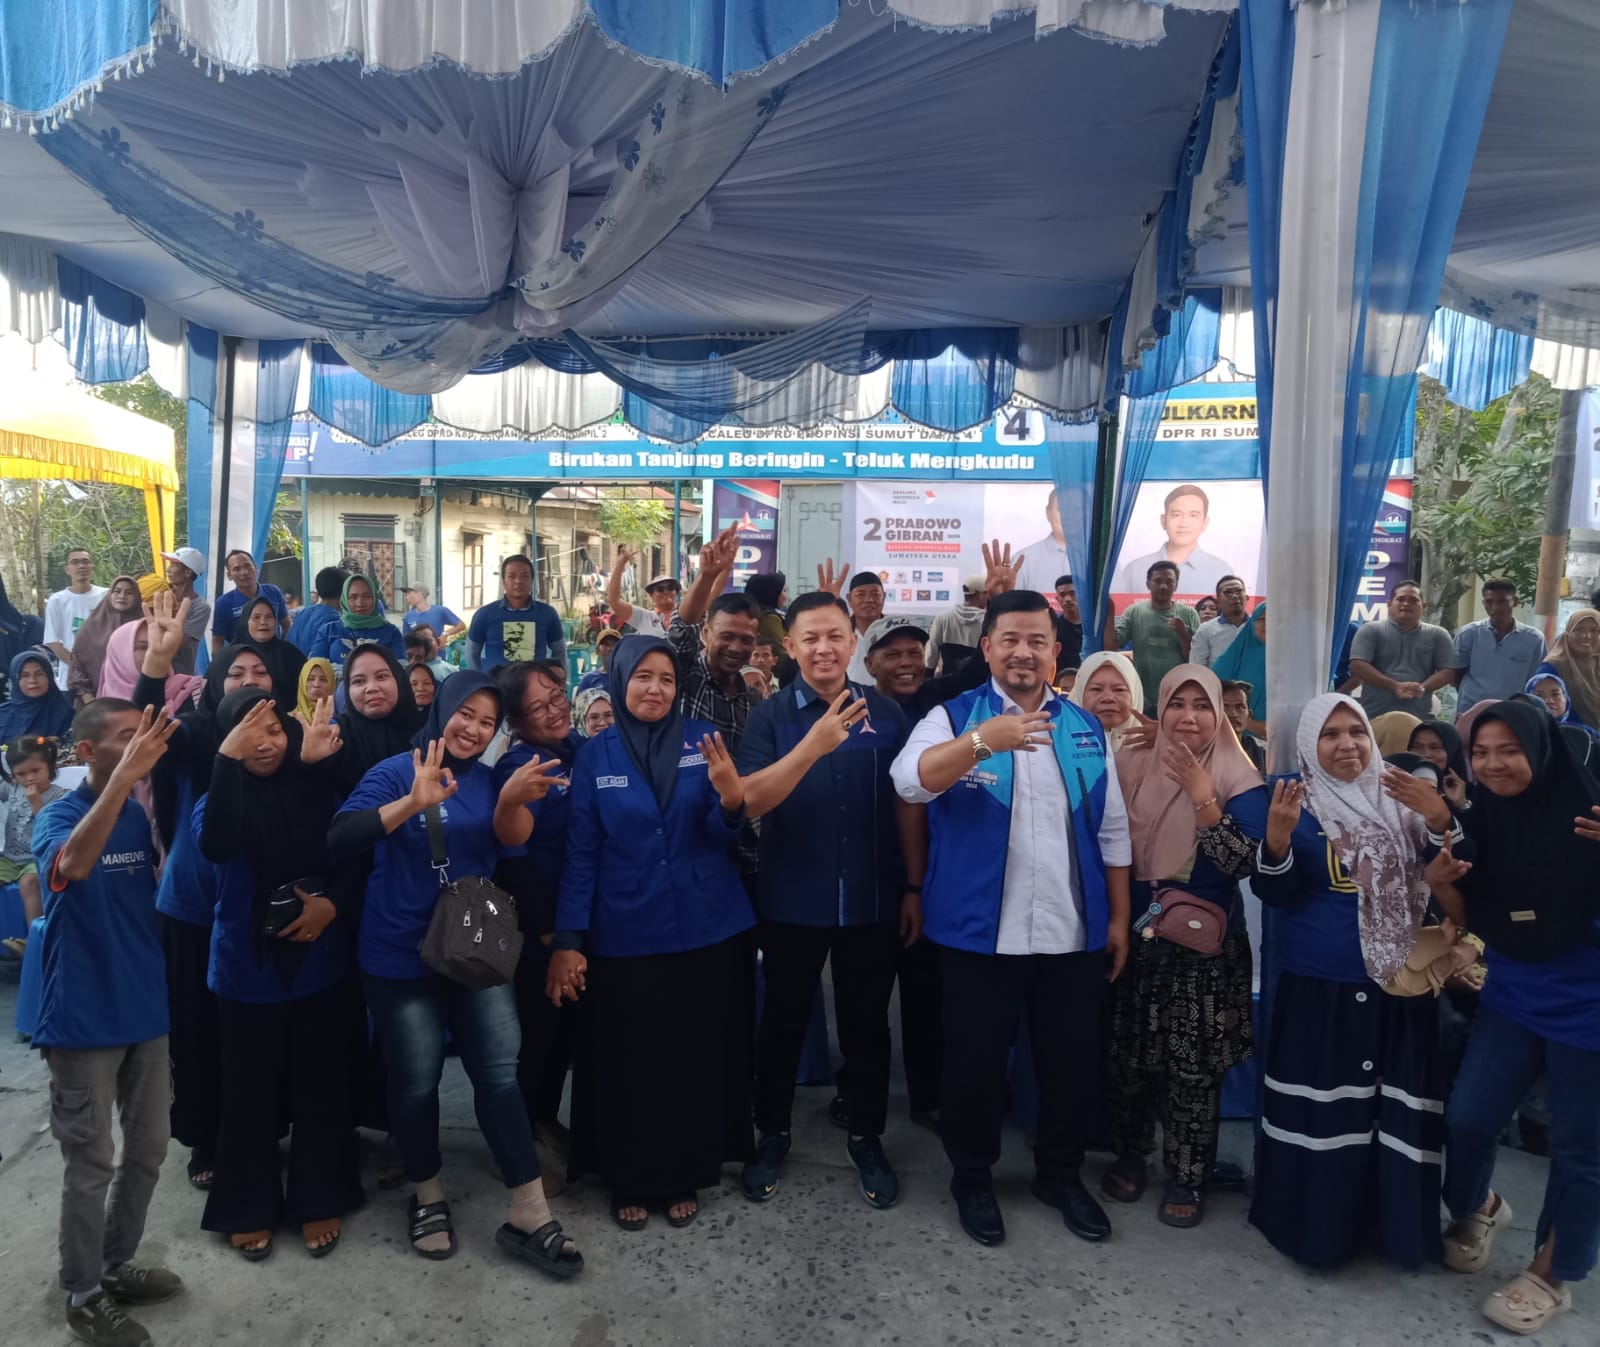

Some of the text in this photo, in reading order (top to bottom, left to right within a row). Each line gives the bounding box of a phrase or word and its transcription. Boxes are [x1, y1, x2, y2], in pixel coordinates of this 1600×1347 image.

[1003, 408, 1030, 441] 4
[865, 429, 914, 439] SUMUT
[1163, 429, 1195, 438] DPR
[1201, 428, 1217, 438] RI
[549, 452, 633, 467] Birukan
[637, 452, 724, 468] Tanjung
[729, 452, 825, 469] Beringin
[843, 452, 905, 468] Teluk
[911, 453, 1035, 469] Mengkudu
[758, 512, 769, 520] 14
[1388, 515, 1399, 523] 14
[864, 517, 882, 541] 2
[885, 518, 961, 529] PRABOWO
[885, 530, 944, 541] GIBRAN
